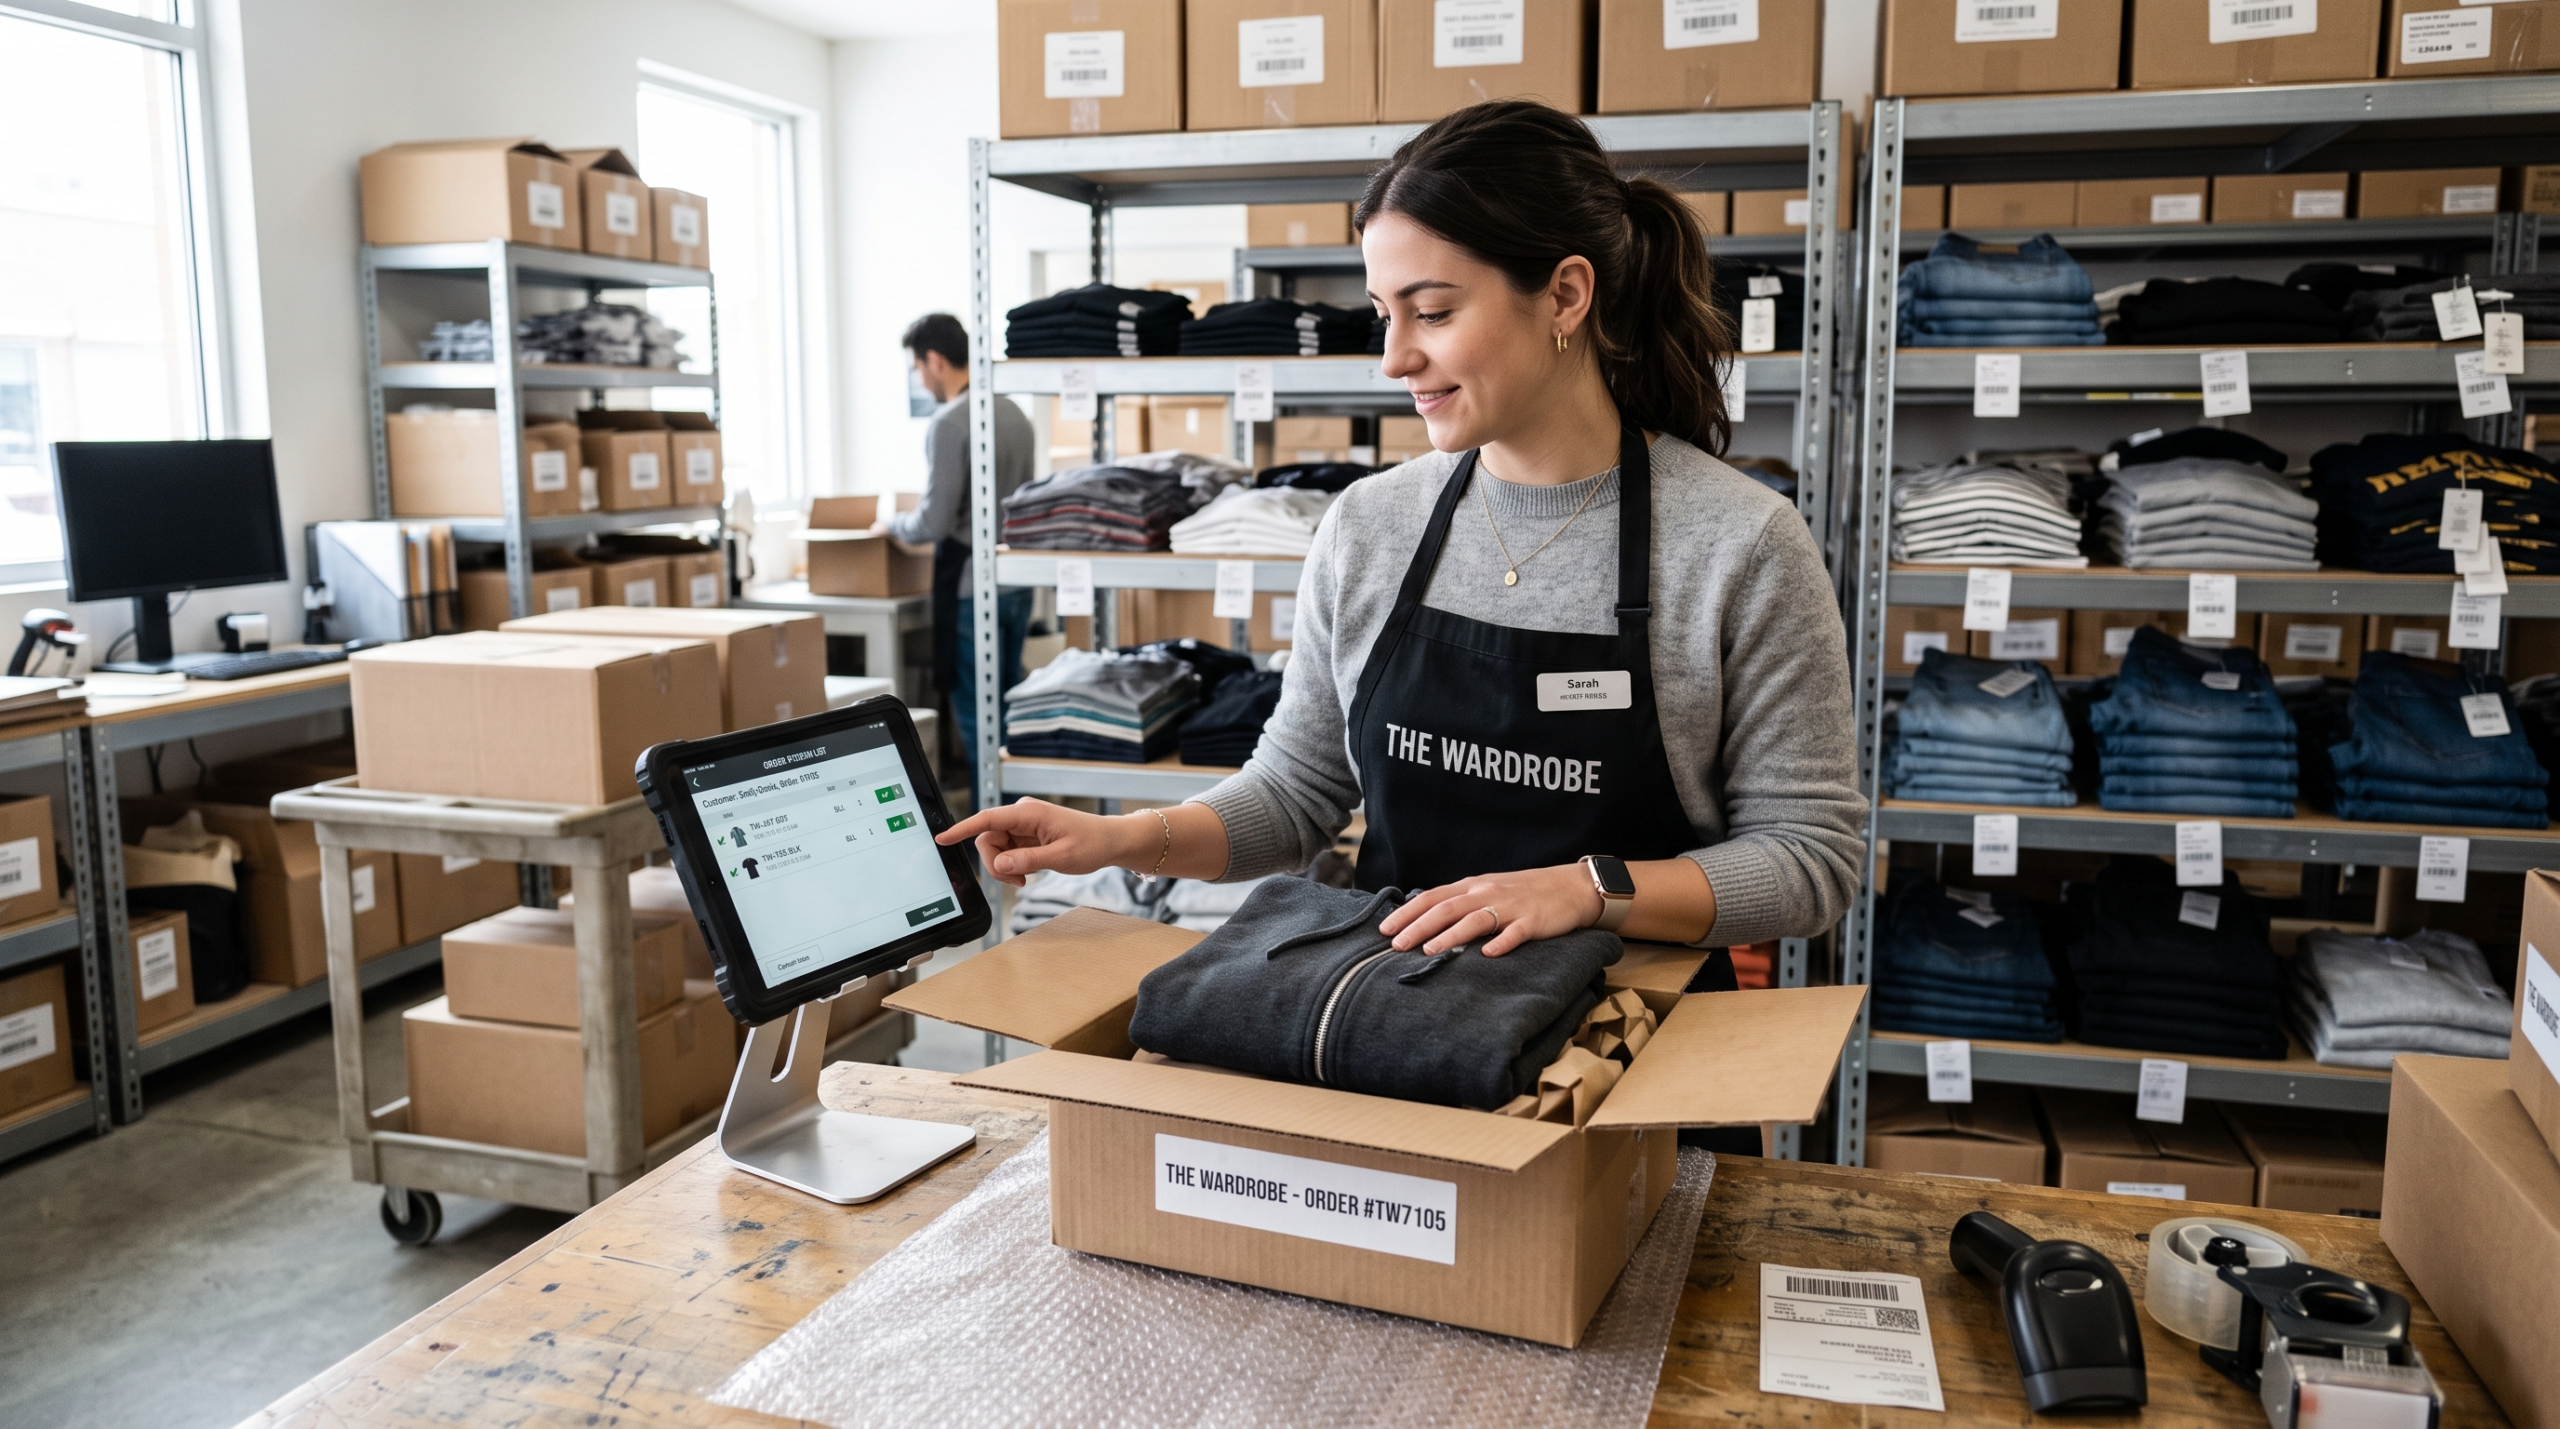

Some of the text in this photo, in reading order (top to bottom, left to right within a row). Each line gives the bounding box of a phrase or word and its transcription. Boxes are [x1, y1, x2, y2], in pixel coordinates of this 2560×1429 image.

[1567, 678, 1599, 689] Sarah
[1386, 722, 1602, 794] THE WARDROBE
[1166, 1163, 1196, 1187] THE
[1200, 1168, 1288, 1203] WARDROBE
[1305, 1187, 1359, 1216] ORDER
[1363, 1198, 1446, 1231] #TW7105
